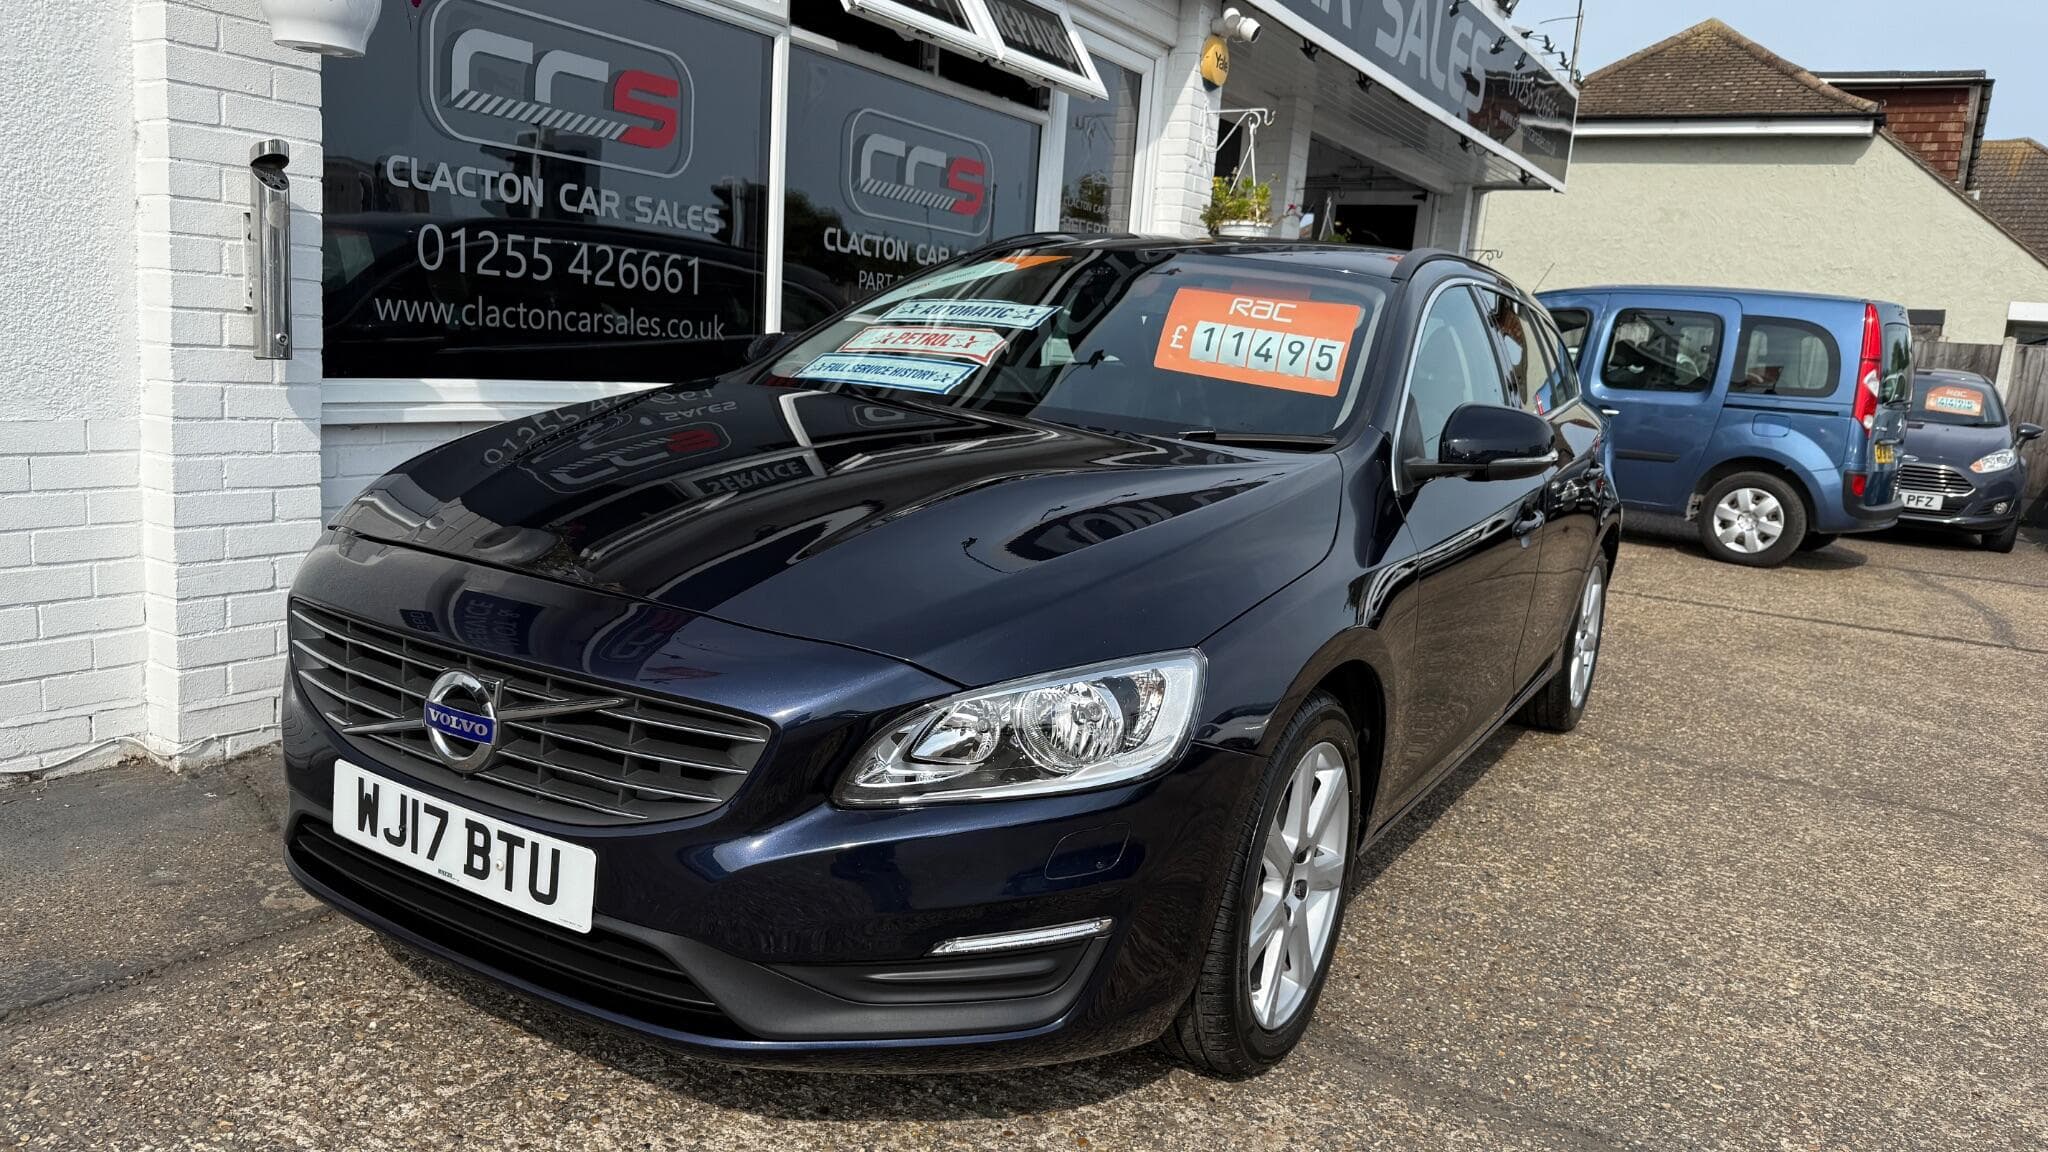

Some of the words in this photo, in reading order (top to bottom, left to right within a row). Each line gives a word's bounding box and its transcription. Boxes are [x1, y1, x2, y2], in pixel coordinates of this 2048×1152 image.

[1375, 0, 1494, 115] SALES
[451, 28, 679, 149] CCS
[386, 154, 544, 208] CLACTON
[560, 183, 620, 219] CAR
[635, 196, 721, 235] SALES
[860, 133, 985, 216] CCS
[418, 223, 552, 281] 01255
[568, 247, 701, 296] 426661
[823, 227, 908, 263] CLACTON
[859, 270, 894, 291] PART
[375, 296, 725, 342] www.clactoncarsales.co.uk
[917, 304, 1012, 319] AUTOMATIC
[894, 331, 953, 348] PETROL
[1202, 326, 1337, 372] 11495
[825, 362, 851, 373] FULL
[851, 364, 891, 376] SERVICE
[891, 366, 937, 381] HISTORY
[1906, 494, 1935, 508] PFZ
[428, 707, 489, 737] VOLVO
[356, 776, 450, 862] WJ17
[463, 817, 562, 906] BTU
